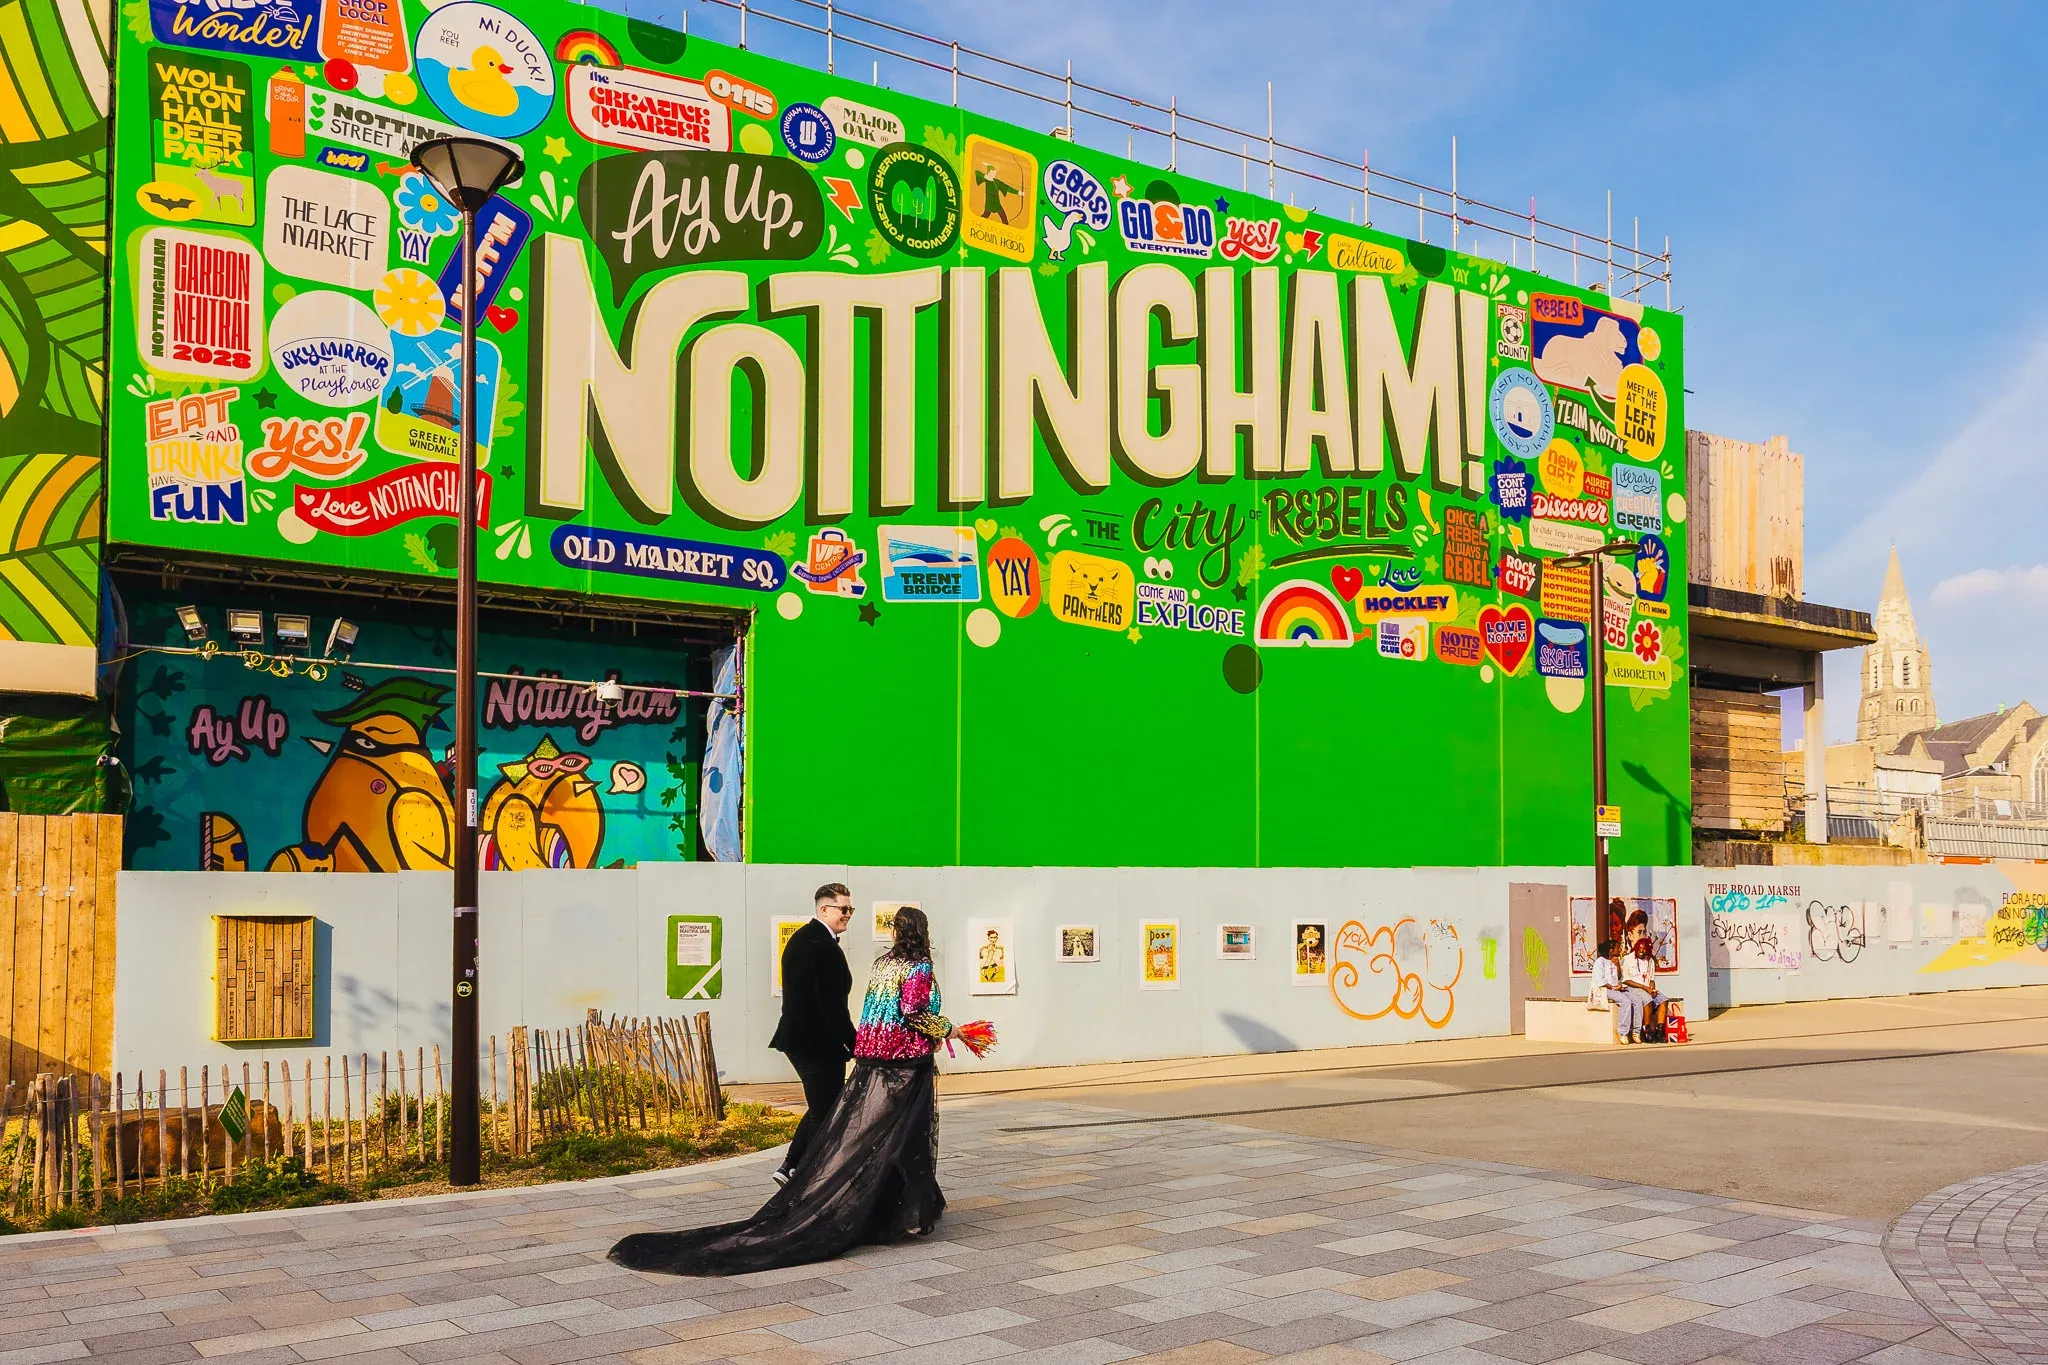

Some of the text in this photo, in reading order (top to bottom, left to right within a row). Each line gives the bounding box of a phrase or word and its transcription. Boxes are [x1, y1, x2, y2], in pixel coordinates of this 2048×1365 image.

[173, 5, 313, 49] Wonder!
[339, 6, 389, 26] LOCAL
[440, 36, 460, 48] REET
[441, 29, 460, 40] YOU
[504, 29, 546, 83] DUCK!
[155, 62, 245, 95] WOLL
[589, 71, 609, 84] the
[160, 84, 242, 113] ATON
[589, 86, 711, 126] CREATIVE
[709, 76, 773, 115] 0115
[163, 103, 242, 131] HALL
[591, 105, 711, 144] QUARTER
[783, 106, 803, 150] NOTTINGHAM
[803, 106, 830, 132] WIGFLEX
[843, 107, 898, 134] MAJOR
[163, 121, 243, 149] DEER
[330, 119, 394, 148] STREET
[825, 131, 834, 149] CITY
[842, 122, 876, 142] OAK
[163, 140, 243, 168] PARK
[799, 146, 830, 160] FESTIVAL
[874, 151, 957, 250] SHERWOOD FOREST SHERWOOD FOREST
[1051, 163, 1108, 226] GOOSE
[282, 195, 377, 237] THE LACE
[611, 159, 721, 264] Ay
[282, 222, 374, 261] MARKET
[400, 230, 431, 263] YAY
[970, 228, 1025, 253] ROBIN HOOD
[1129, 241, 1208, 257] EVERYTHING
[1220, 219, 1279, 260] YES!
[174, 242, 251, 301] CARBON
[1451, 265, 1469, 285] YAY
[152, 238, 166, 357] NOTTINGHAM
[1534, 298, 1579, 319] REBELS
[173, 292, 252, 352] NEUTRAL
[1497, 304, 1527, 323] FOREST
[173, 344, 252, 369] 2028
[1498, 341, 1528, 360] COUNTY
[319, 364, 348, 374] AT THE
[536, 233, 1488, 522] NOTTINGHAM!
[301, 376, 381, 397] Playhouse
[1626, 380, 1658, 400] MEET ME
[1626, 391, 1657, 411] AT THE
[149, 389, 238, 442] EAT
[1556, 399, 1588, 431] TEAM
[1625, 405, 1657, 429] LEFT
[206, 426, 237, 442] AND
[409, 428, 458, 447] GREEN'S
[1624, 423, 1656, 447] LION
[251, 416, 366, 478] YES!
[408, 438, 457, 457] WINDMILL
[150, 441, 242, 480] DRINK!
[1547, 449, 1578, 473] new
[151, 475, 175, 488] HAVE
[152, 480, 245, 523] FUN
[311, 469, 486, 526] Love NOTTINGH
[1533, 493, 1608, 524] Discover
[1446, 508, 1487, 531] ONCE A
[1616, 512, 1662, 530] GREATS
[1086, 483, 1408, 589] THE City OF REBELS
[1446, 524, 1489, 548] REBEL
[563, 534, 779, 589] OLD MARKET SQ.
[1445, 541, 1489, 561] ALWAYS A
[995, 557, 1031, 596] YAY
[1378, 560, 1424, 592] Love
[1445, 553, 1491, 587] REBEL
[1505, 554, 1537, 577] ROCK
[1543, 563, 1590, 577] NOINGHA
[901, 573, 962, 585] TRENT
[903, 585, 962, 595] BRIDGE
[1505, 571, 1536, 592] CITY
[1543, 572, 1590, 586] NOTTINGHA
[1543, 582, 1590, 595] NOTTINGHA
[1138, 584, 1185, 602] COME AND
[1364, 595, 1449, 613] HOCKLEY
[1543, 591, 1590, 604] NOTTINGHA
[1062, 594, 1122, 625] PANTHERS
[1138, 601, 1245, 635] EXPLORE
[1543, 602, 1590, 614] NOTTINGHA
[1544, 610, 1590, 623] NOTTINGHA
[1485, 620, 1527, 633] LOVE
[1603, 611, 1628, 630] REET
[1380, 645, 1400, 654] CLUB
[1440, 631, 1480, 649] NOTTS
[1440, 645, 1480, 660] PRIDE
[1539, 645, 1582, 668] SKATE
[1541, 665, 1584, 676] NOTTINGHAM
[1612, 668, 1666, 681] ARBORETUM
[191, 699, 286, 762] Ay Up
[1708, 884, 1801, 897] THE BROAD MARSH
[2002, 892, 2030, 905] FLORA
